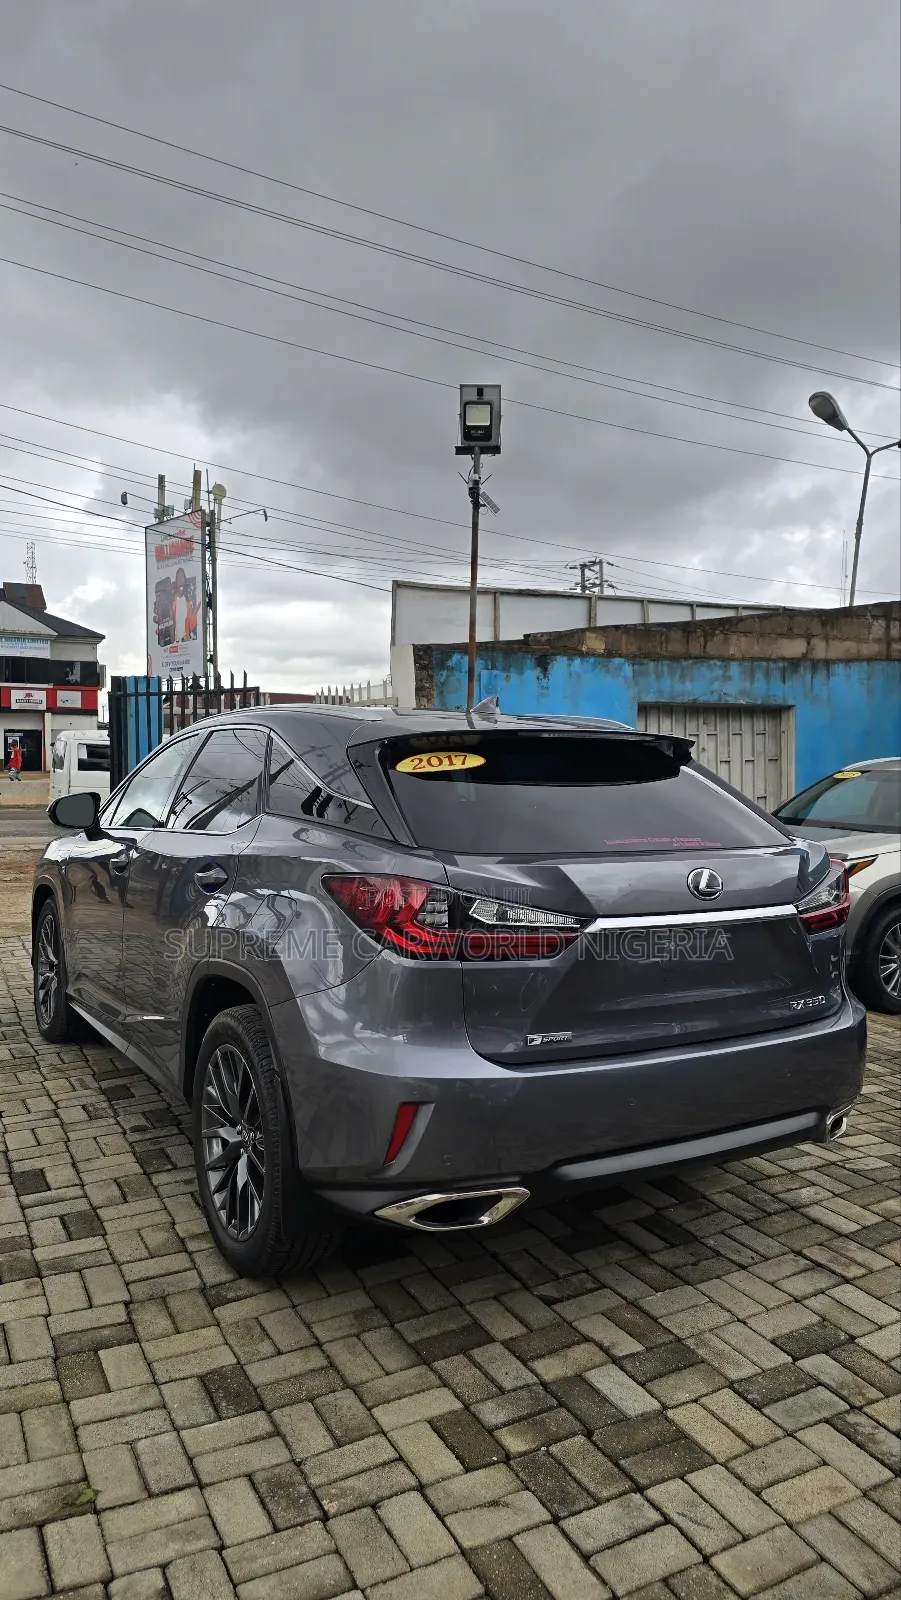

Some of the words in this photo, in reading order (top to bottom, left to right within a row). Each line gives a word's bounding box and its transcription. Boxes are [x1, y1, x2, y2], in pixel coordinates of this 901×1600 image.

[410, 755, 468, 770] 2017
[790, 1000, 805, 1011] RX
[542, 1035, 568, 1043] SPORT
